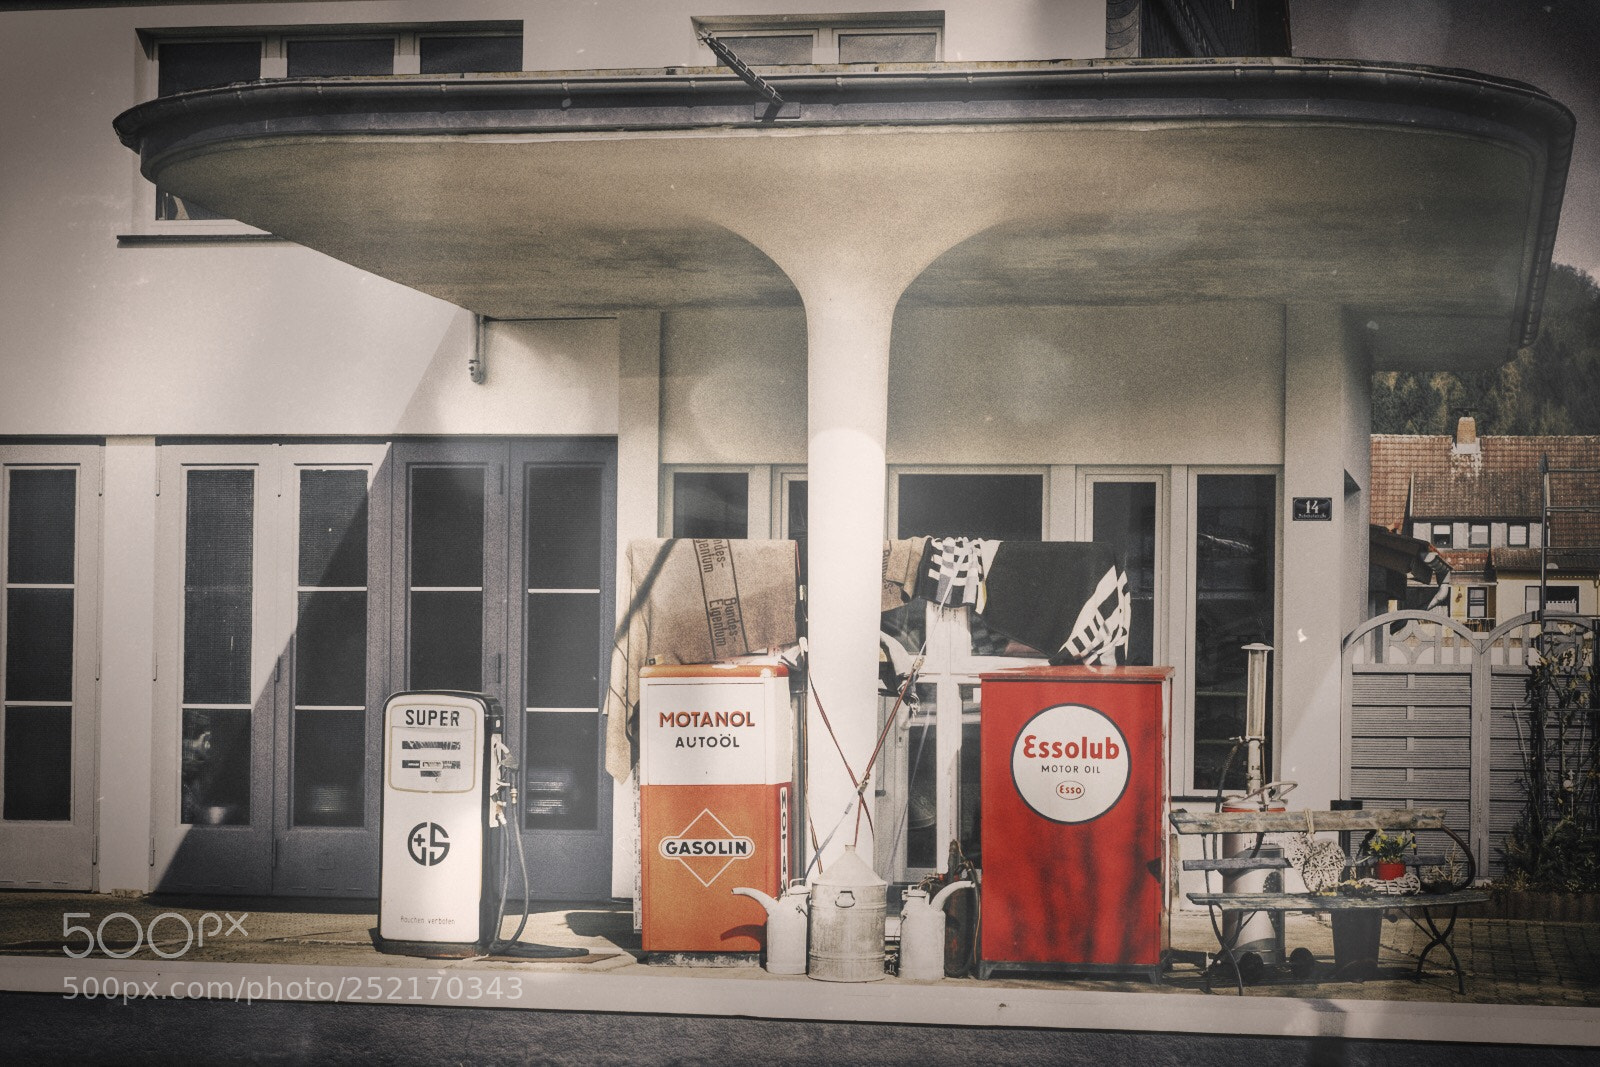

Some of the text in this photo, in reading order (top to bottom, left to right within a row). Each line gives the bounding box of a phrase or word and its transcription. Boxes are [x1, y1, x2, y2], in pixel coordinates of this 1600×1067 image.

[1305, 500, 1319, 514] 14
[709, 598, 728, 647] Eigentum
[723, 597, 740, 642] Bundes-
[405, 709, 460, 727] SUPER
[659, 710, 756, 728] MOTANOL
[675, 733, 740, 748] AUTOÖL
[1023, 734, 1120, 760] Essolub
[1041, 765, 1101, 774] MOTOR OIL
[1059, 784, 1082, 794] Esso
[665, 840, 748, 855] GASOLIN
